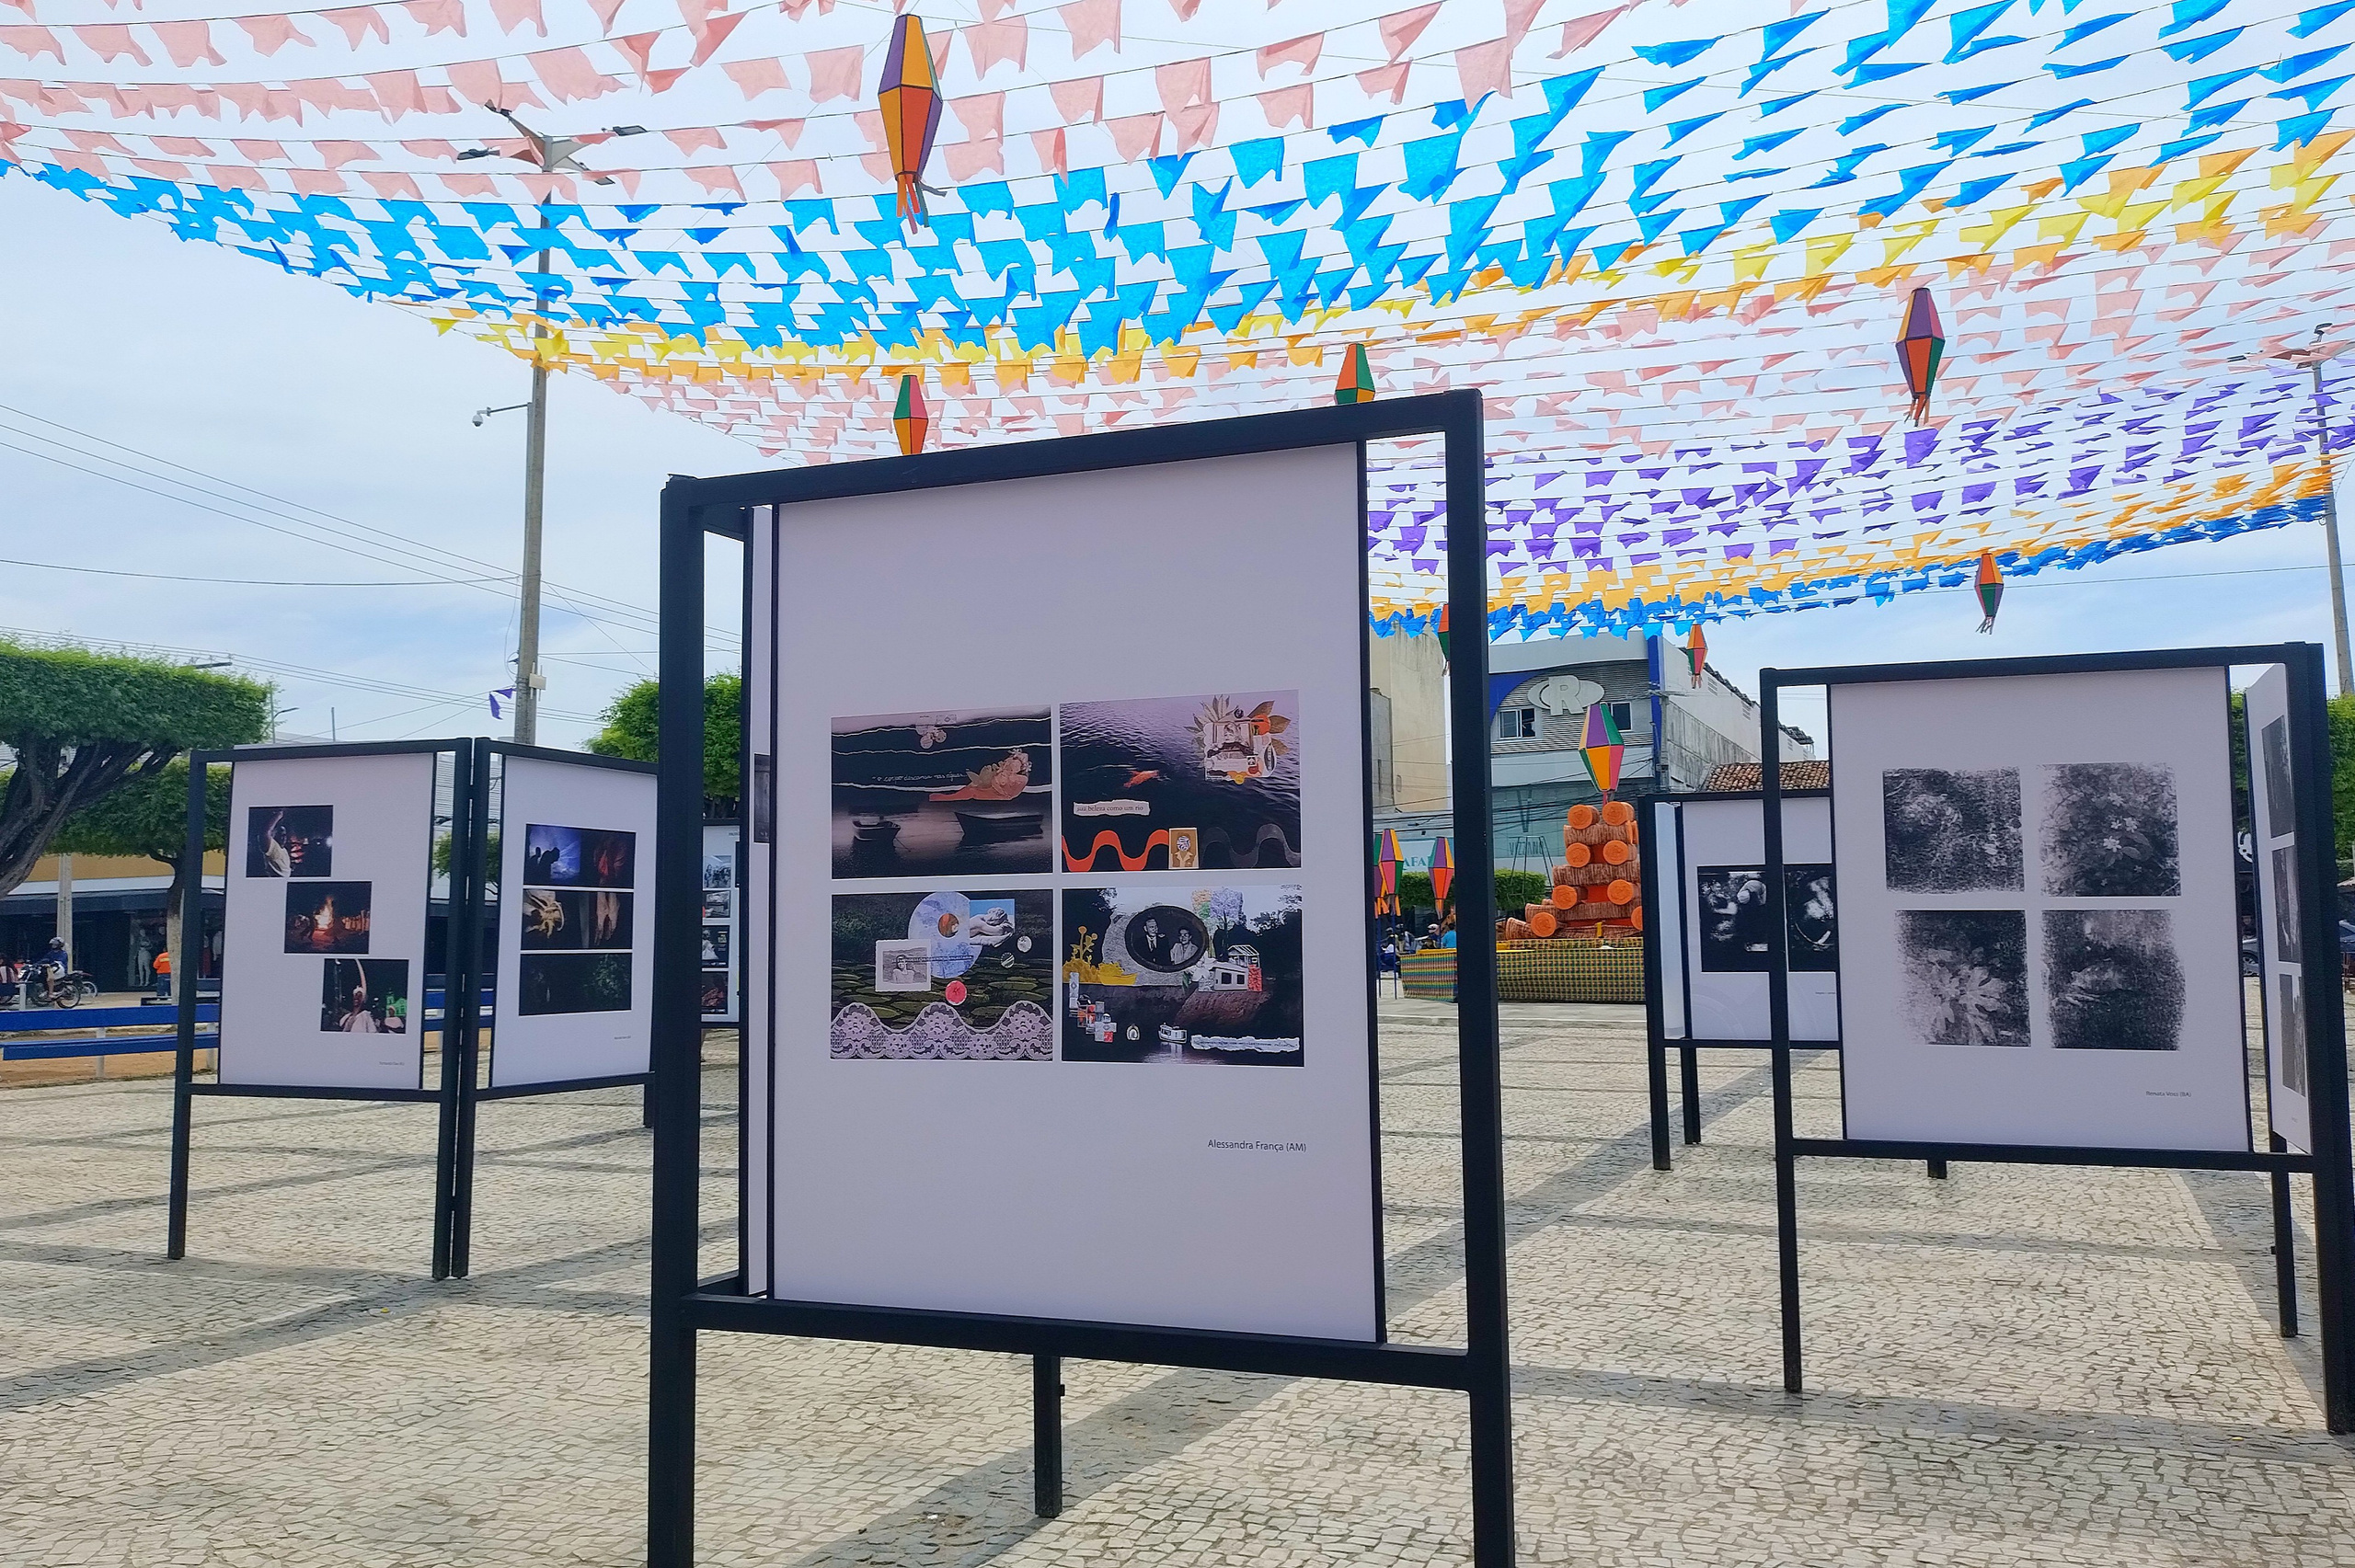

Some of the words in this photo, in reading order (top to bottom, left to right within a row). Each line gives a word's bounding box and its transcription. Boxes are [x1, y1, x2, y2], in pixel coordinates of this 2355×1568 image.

[1207, 1139, 1254, 1150] Alessandra
[1255, 1140, 1284, 1153] França
[1285, 1142, 1307, 1153] (AM)
